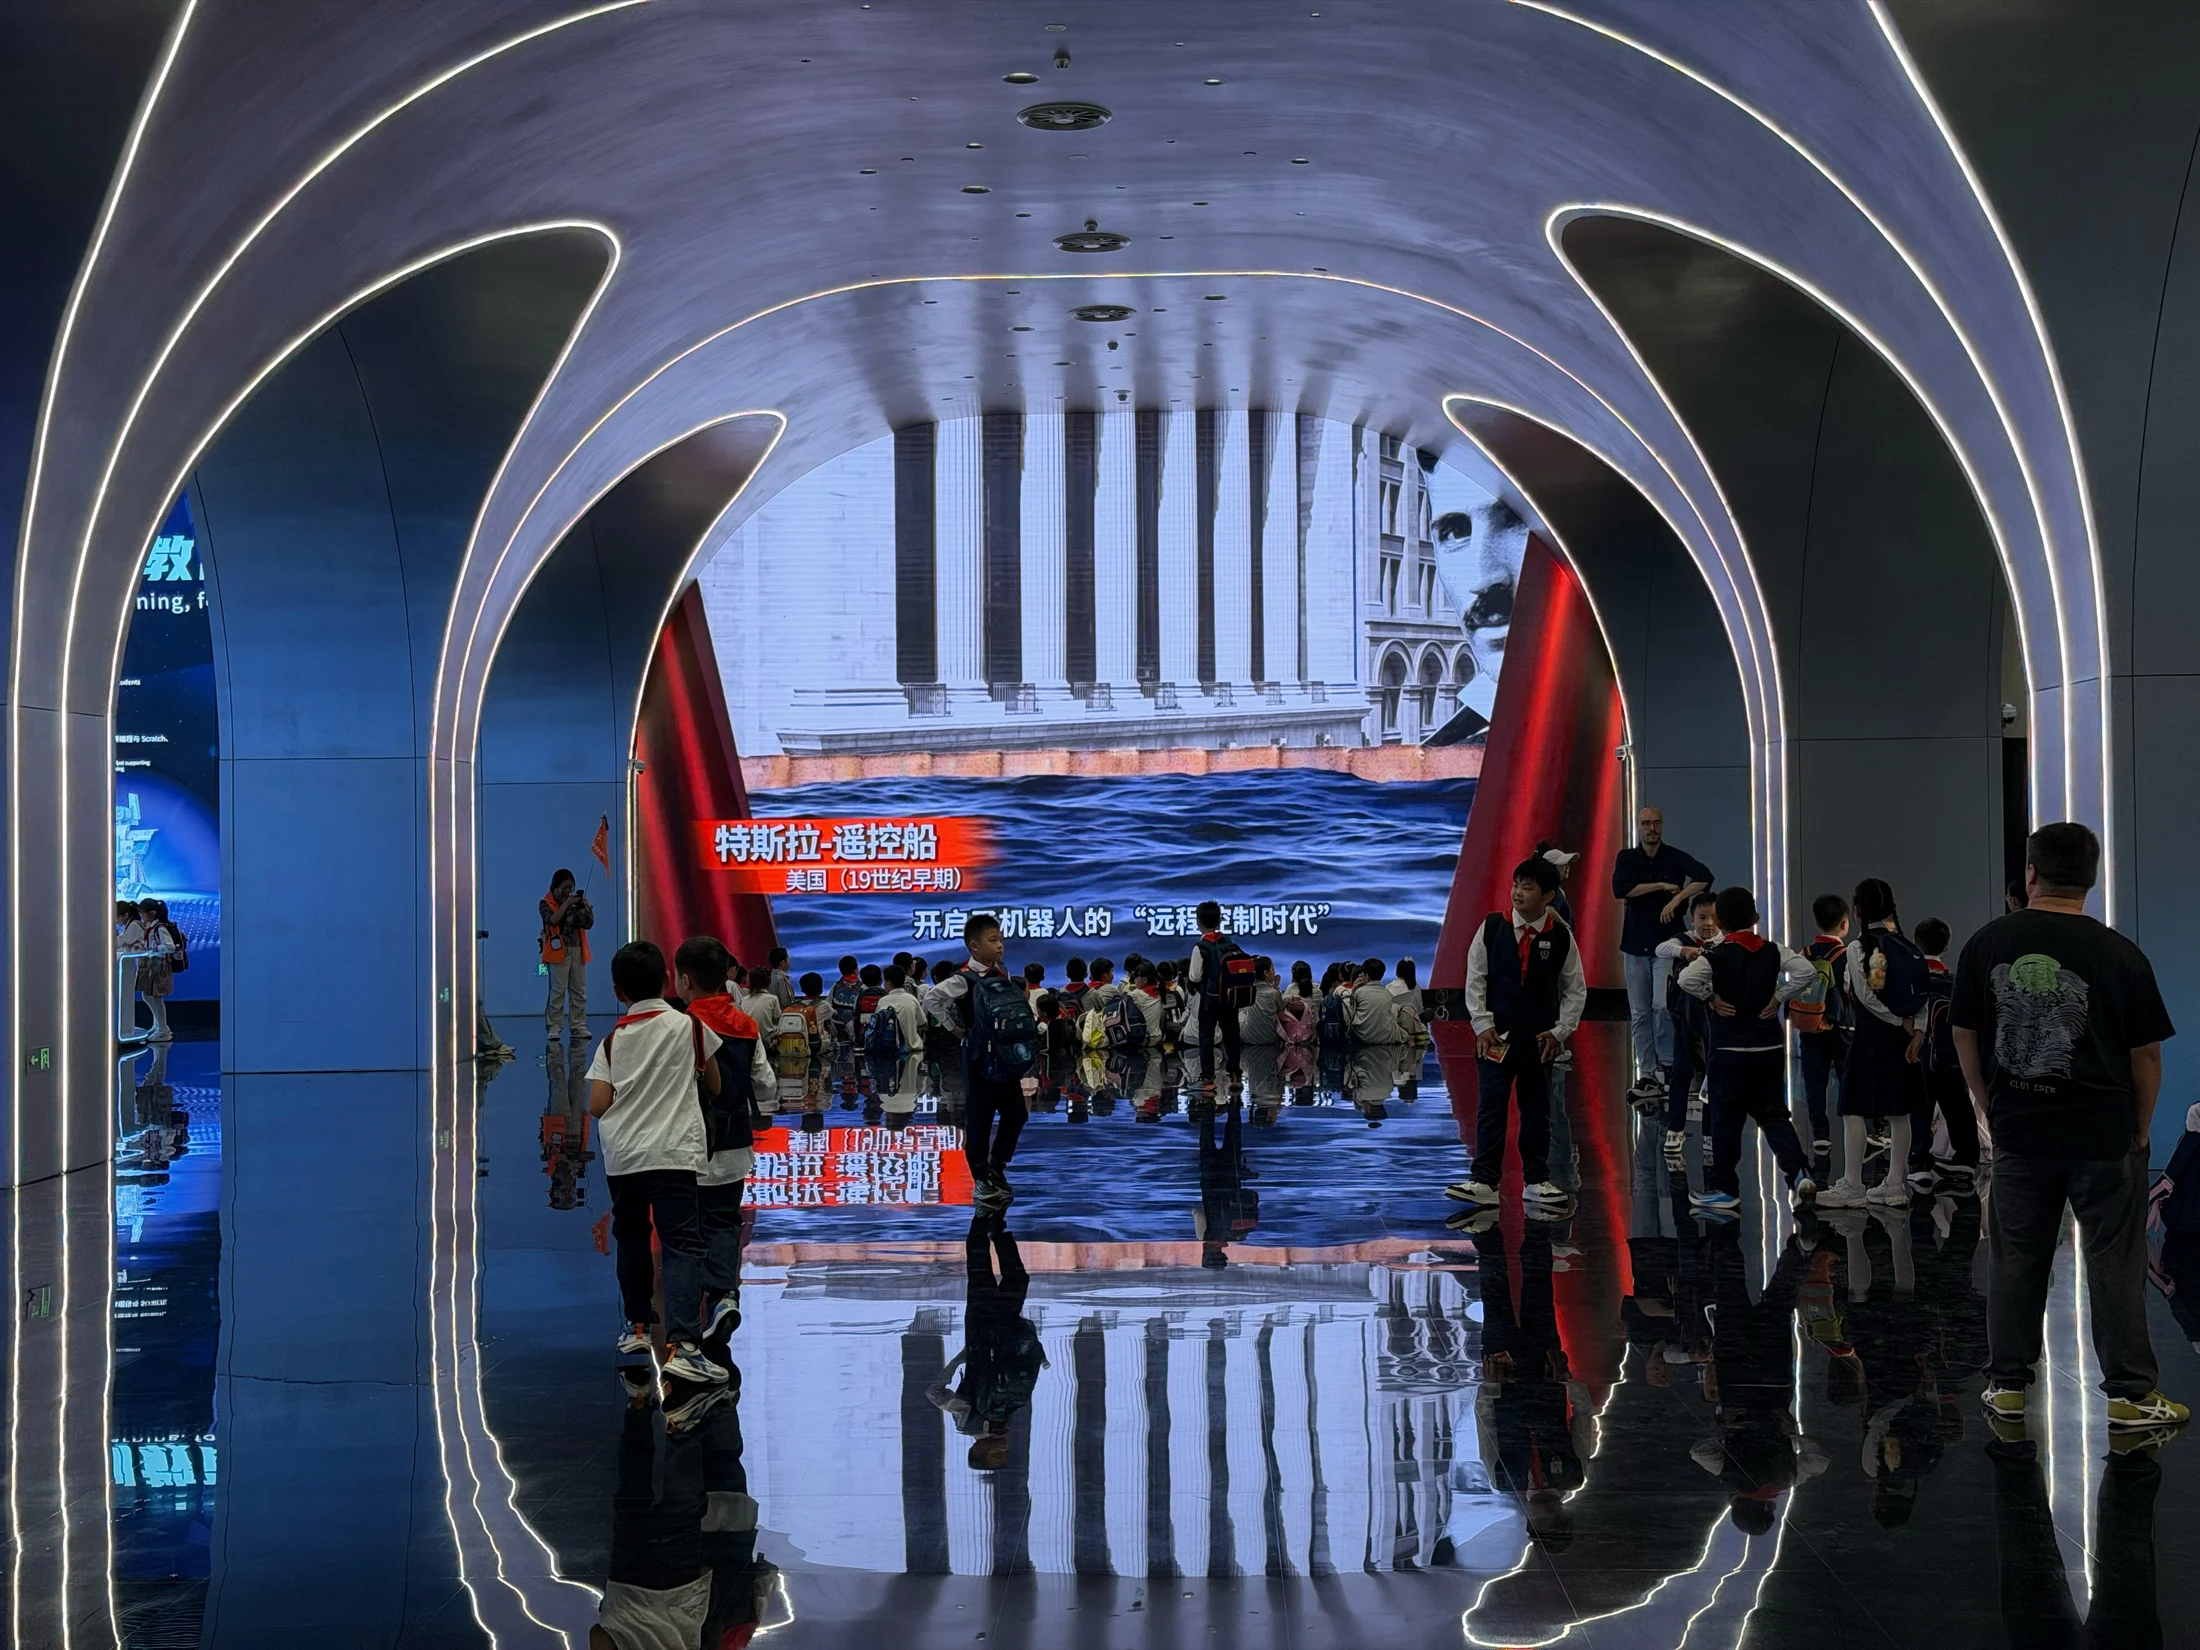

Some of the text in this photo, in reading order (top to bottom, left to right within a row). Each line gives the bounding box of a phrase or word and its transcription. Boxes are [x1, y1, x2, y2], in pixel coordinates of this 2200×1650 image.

[714, 823, 937, 862] 特斯拉-遥控船
[786, 868, 963, 892] 美国（19世纪早期）
[913, 903, 1330, 938] 开启机器人的“远程制时代”
